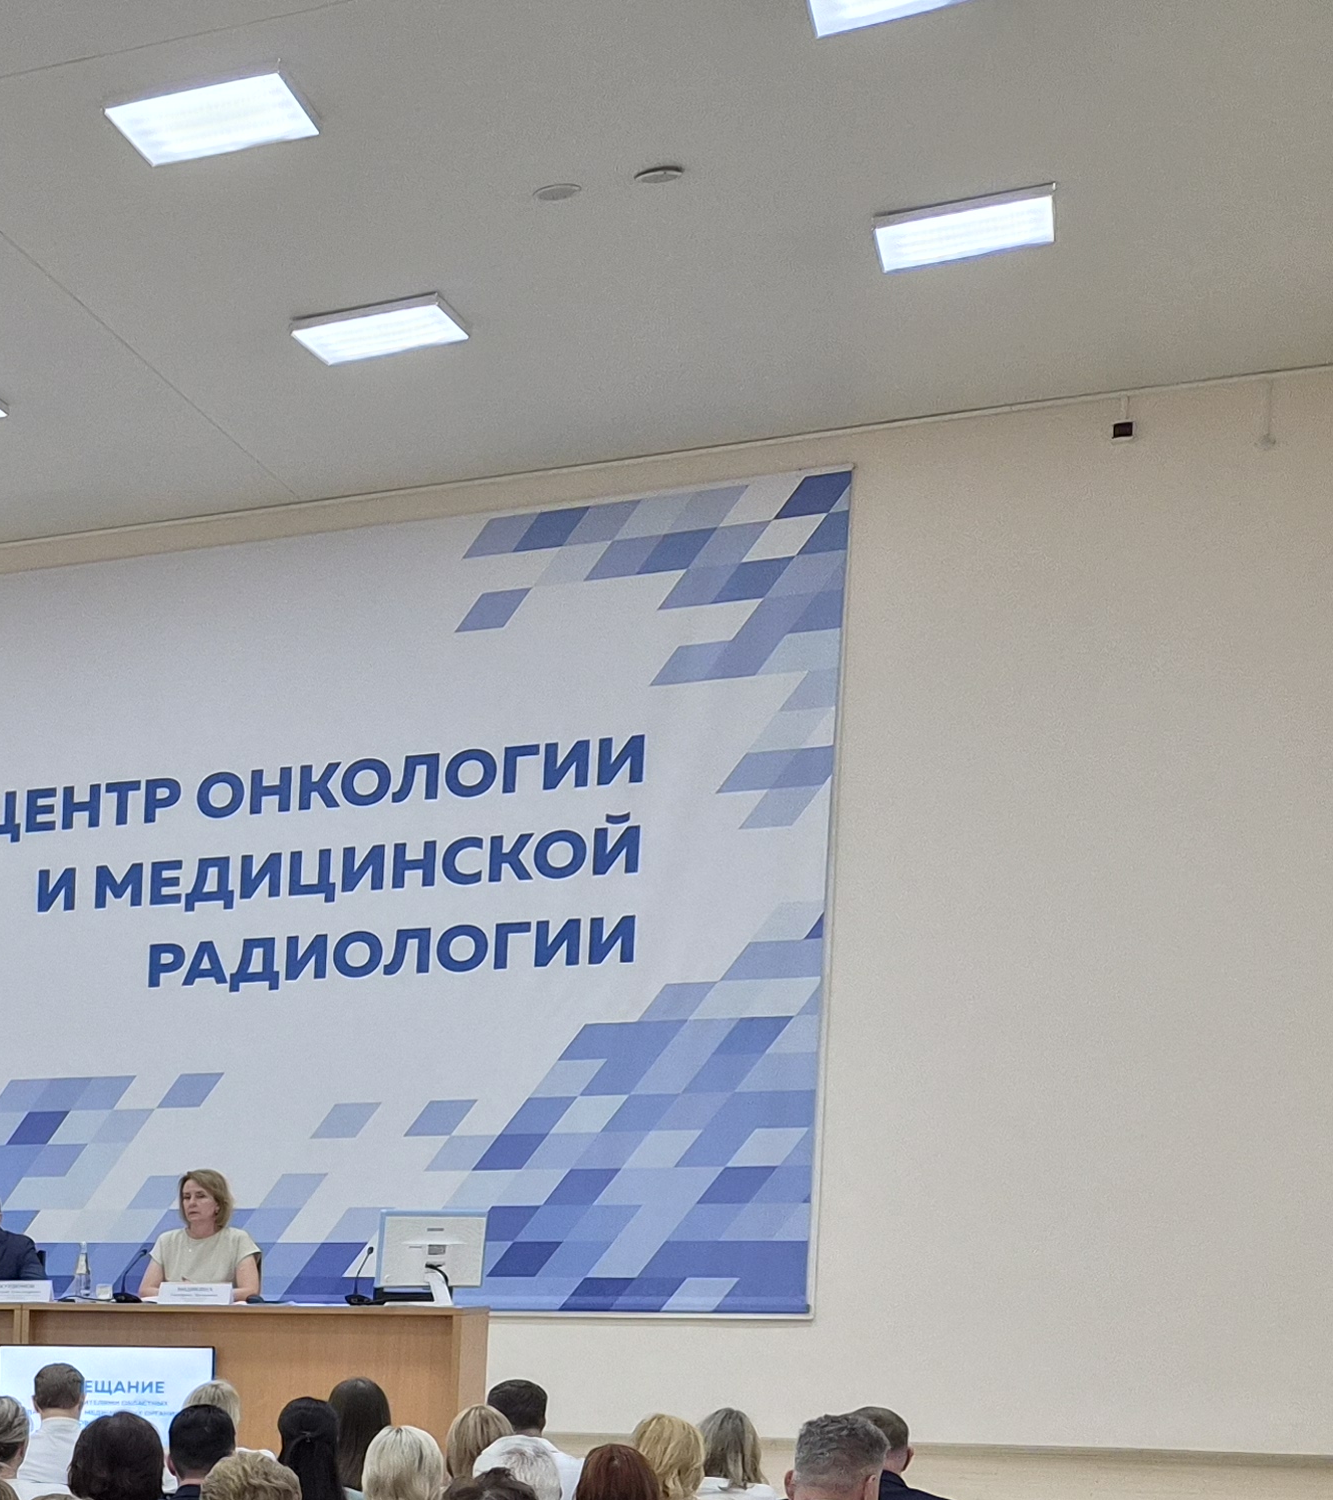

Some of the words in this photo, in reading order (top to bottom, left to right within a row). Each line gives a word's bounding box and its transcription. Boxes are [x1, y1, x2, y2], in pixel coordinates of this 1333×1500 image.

[195, 734, 646, 819] ОНКОЛОГИИ
[36, 867, 76, 913] И
[94, 812, 641, 911] МЕДИЦИНСКОЙ
[147, 915, 636, 993] РАДИОЛОГИИ
[84, 1380, 165, 1395] ЕЩАНИЕ
